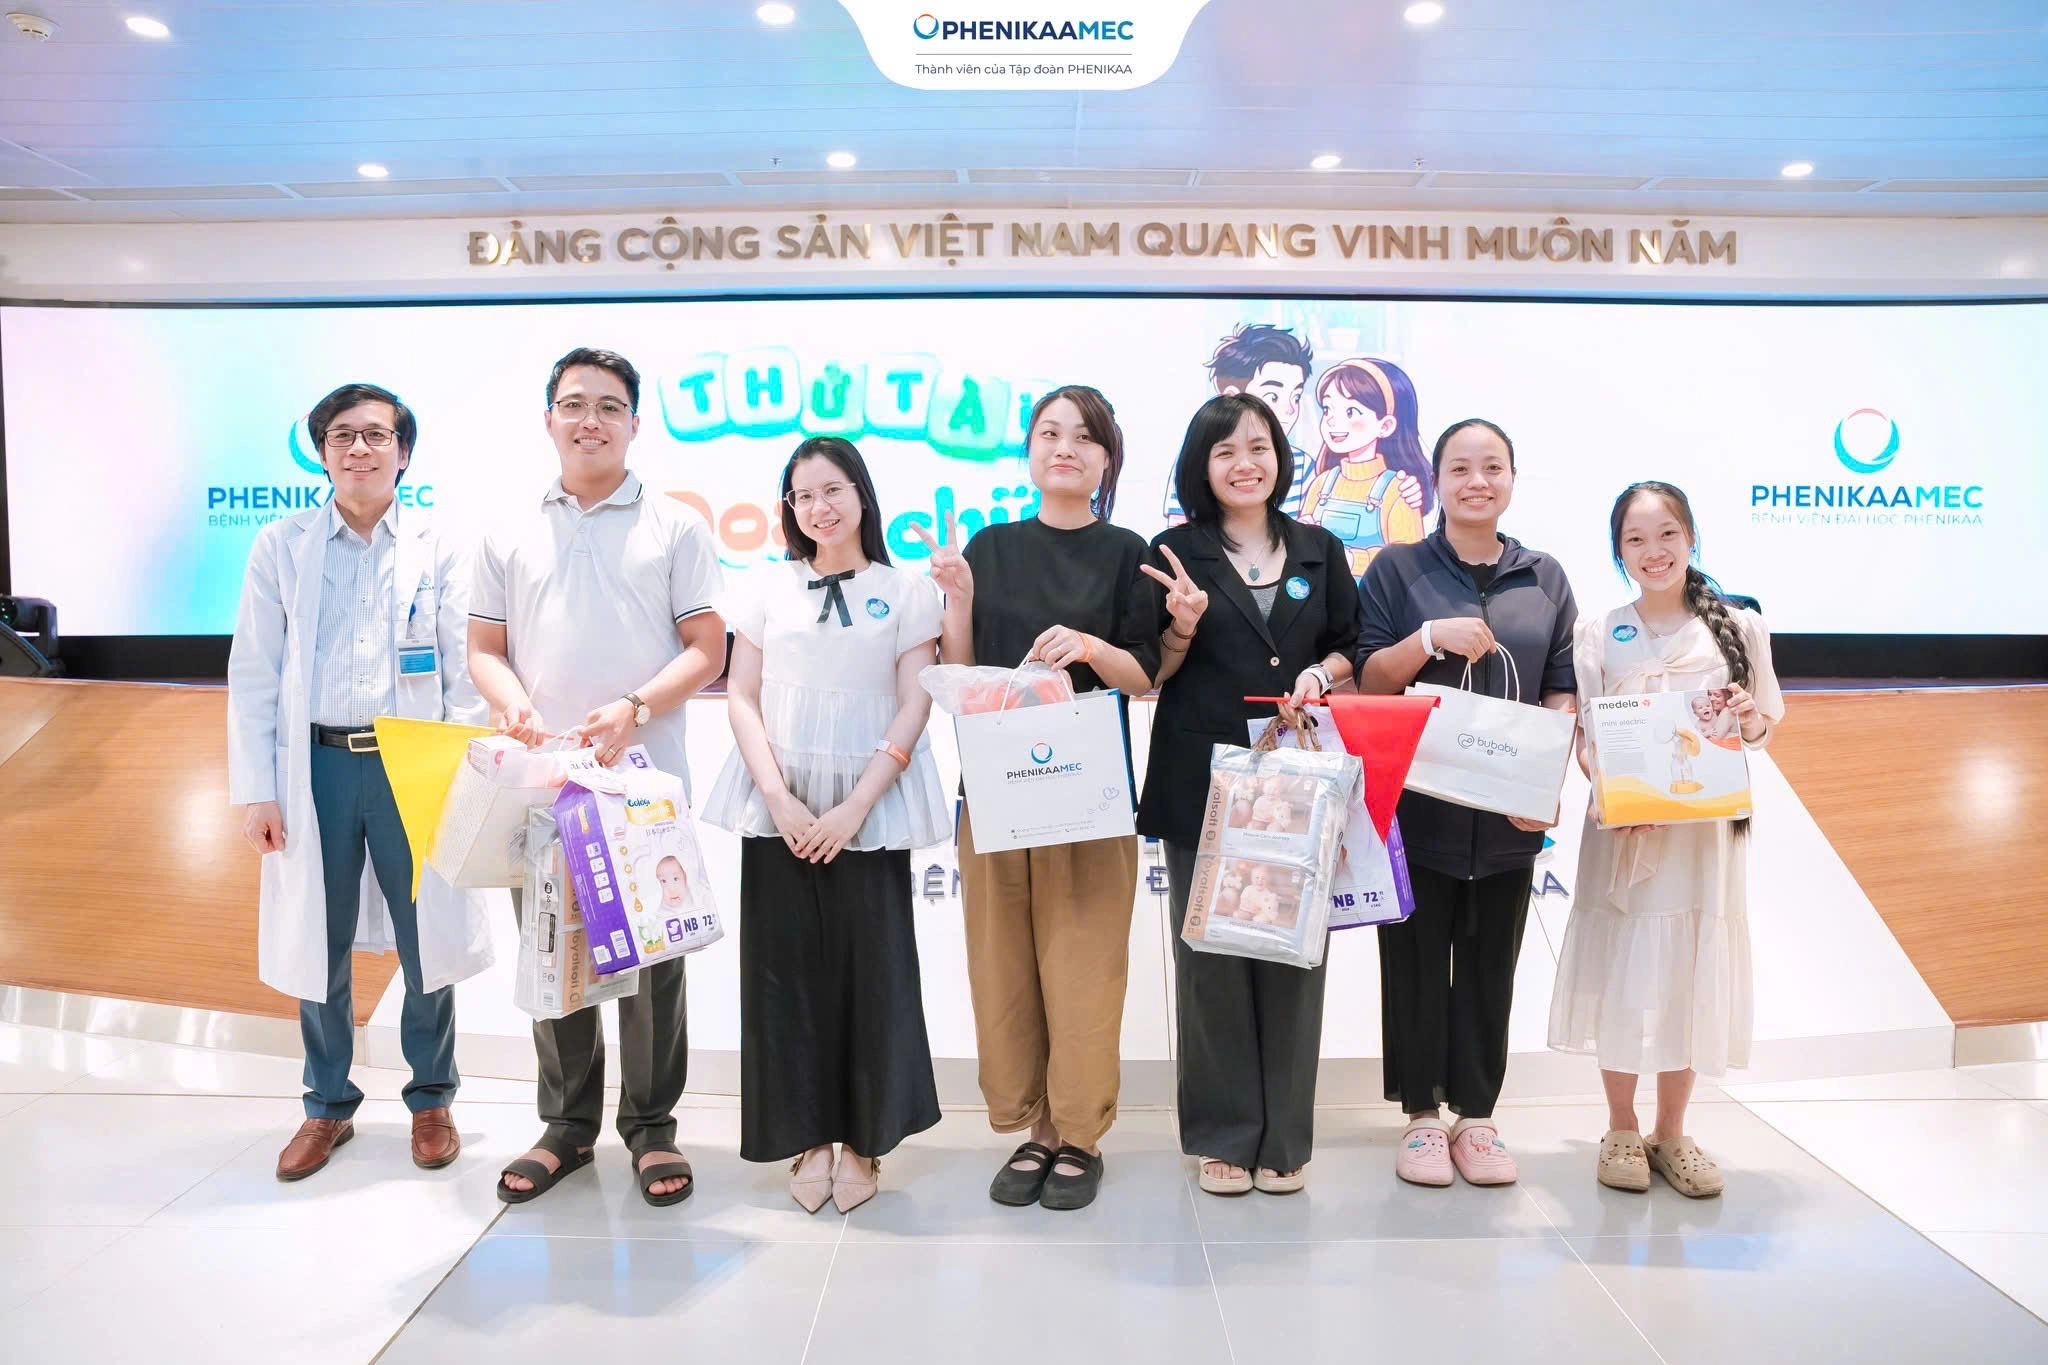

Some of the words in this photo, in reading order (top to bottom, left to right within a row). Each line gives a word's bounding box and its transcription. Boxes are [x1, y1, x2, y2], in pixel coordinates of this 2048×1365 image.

[467, 219, 601, 266] ĐẢNG
[616, 216, 761, 270] CỘNG
[777, 213, 872, 261] SẢN
[889, 212, 994, 266] VIỆT
[1011, 222, 1120, 258] NAM
[1136, 221, 1316, 258] QUANG
[1333, 223, 1450, 261] VINH
[1467, 217, 1614, 263] MUÔN
[1630, 219, 1737, 266] NĂM
[208, 486, 434, 509] PHENIKEC
[1751, 485, 1984, 508] PHENIKAAMEC
[256, 513, 284, 526] VIỆ
[1904, 513, 1983, 525] PHENIKAA
[1598, 699, 1639, 709] medela
[1477, 736, 1518, 757] bubaby
[1006, 762, 1083, 780] PHENIKAAMEC
[1208, 785, 1222, 826] yalsoft
[1333, 893, 1355, 908] NB
[1363, 891, 1379, 903] 72
[683, 917, 699, 933] NB
[702, 914, 713, 927] 72
